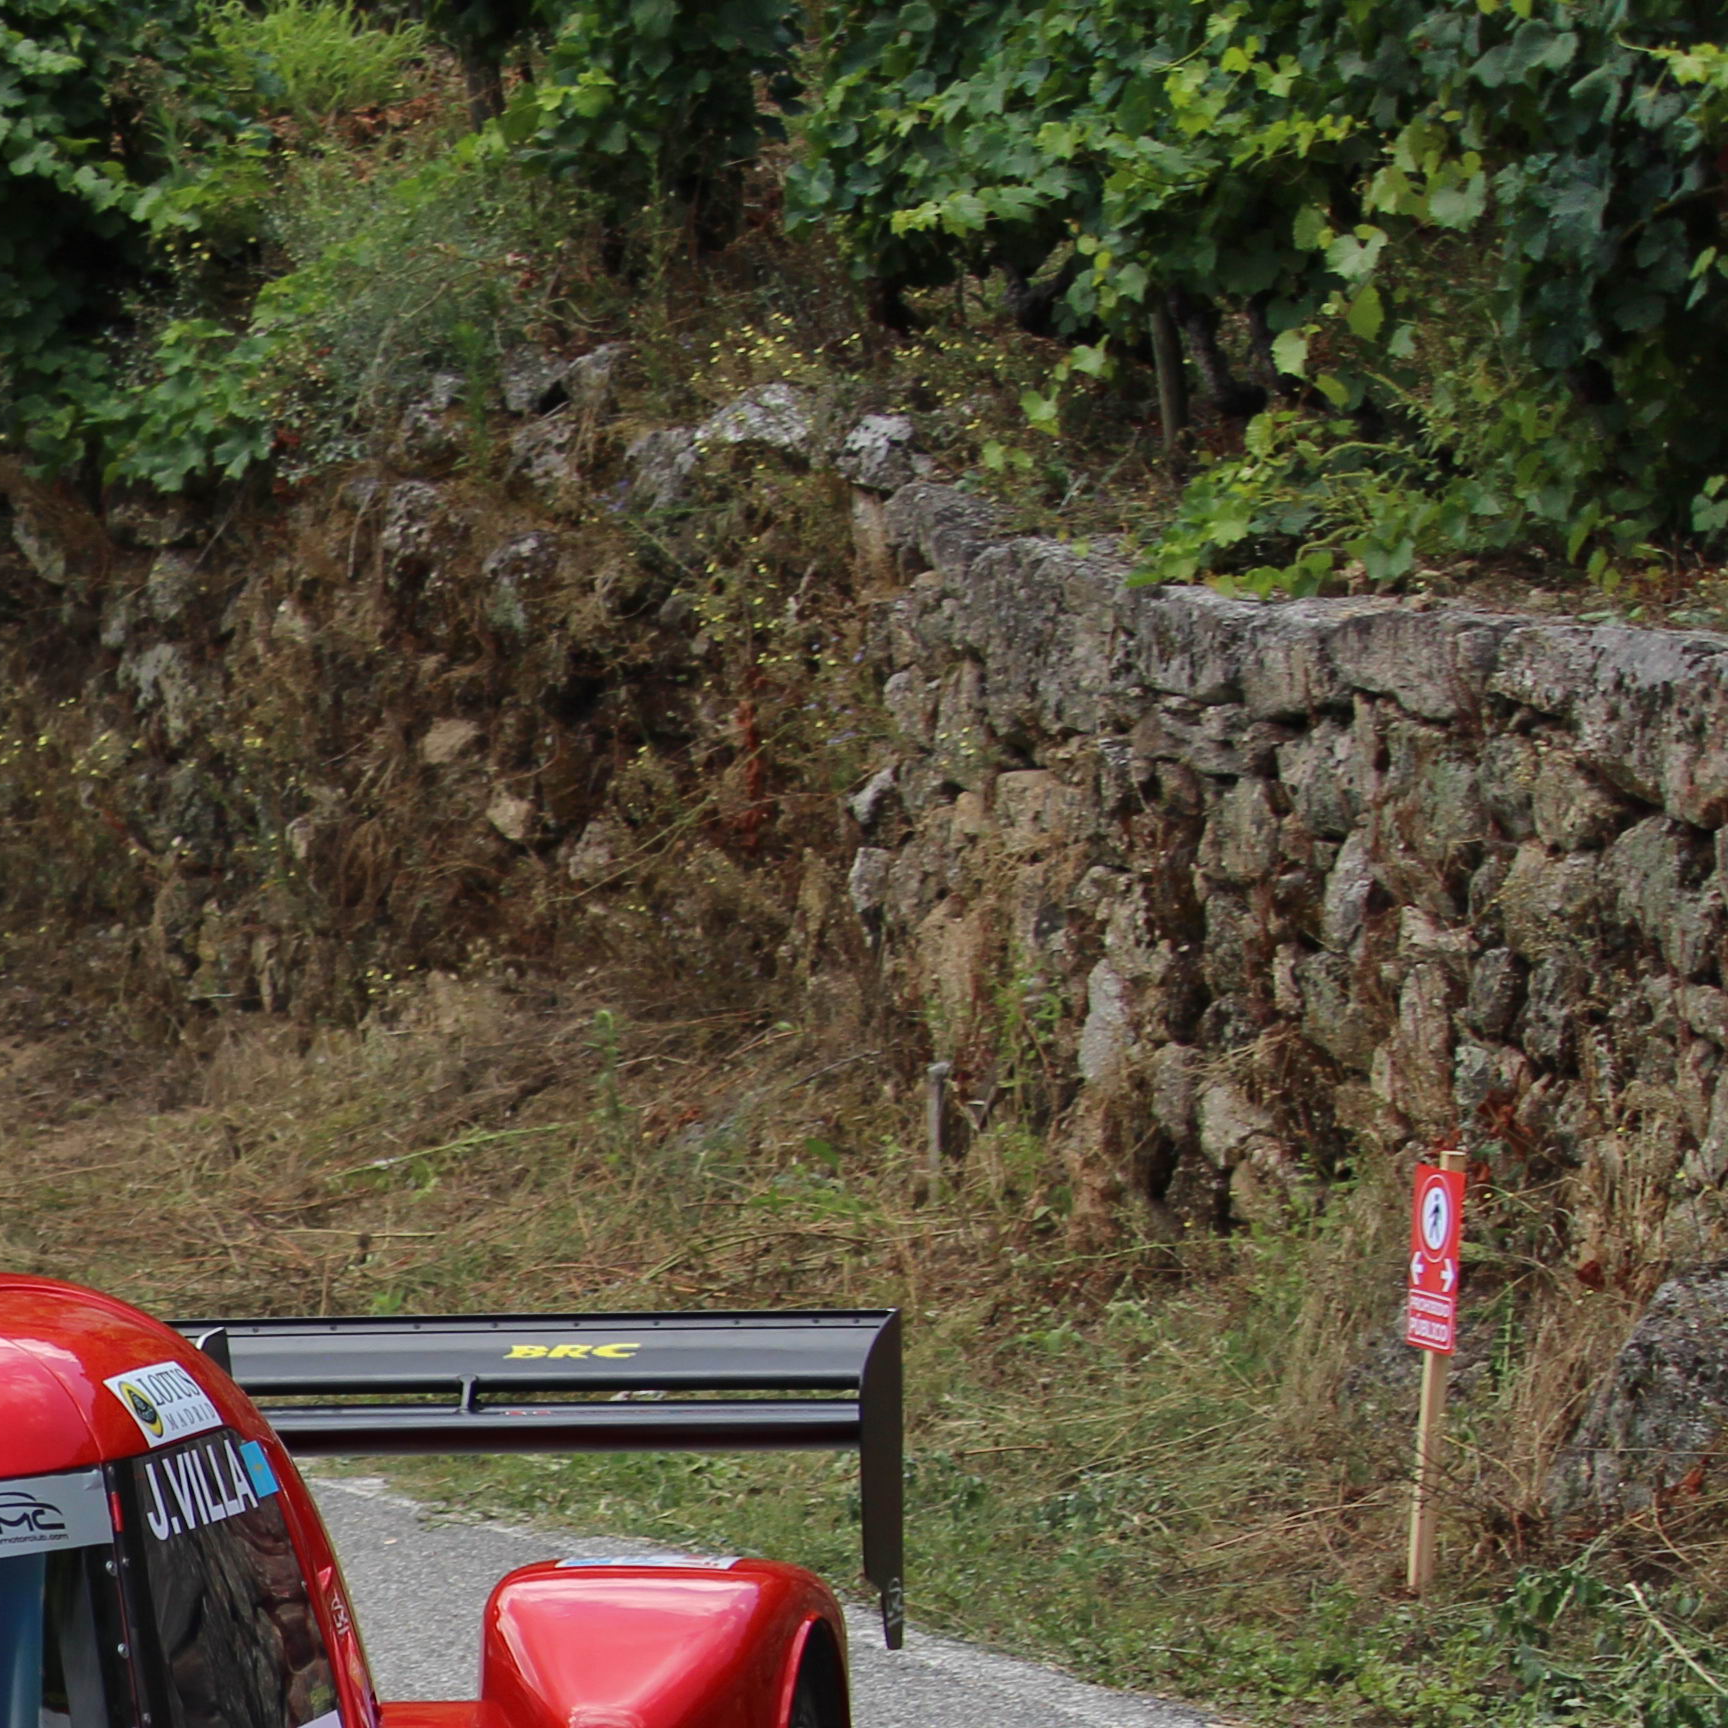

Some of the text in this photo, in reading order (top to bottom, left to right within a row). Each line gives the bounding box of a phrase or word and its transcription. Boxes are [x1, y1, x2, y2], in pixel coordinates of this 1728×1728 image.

[503, 1342, 641, 1359] BRC
[137, 1368, 202, 1406] LOTUS
[164, 1402, 217, 1432] MADRID
[145, 1439, 259, 1541] J.VILLA
